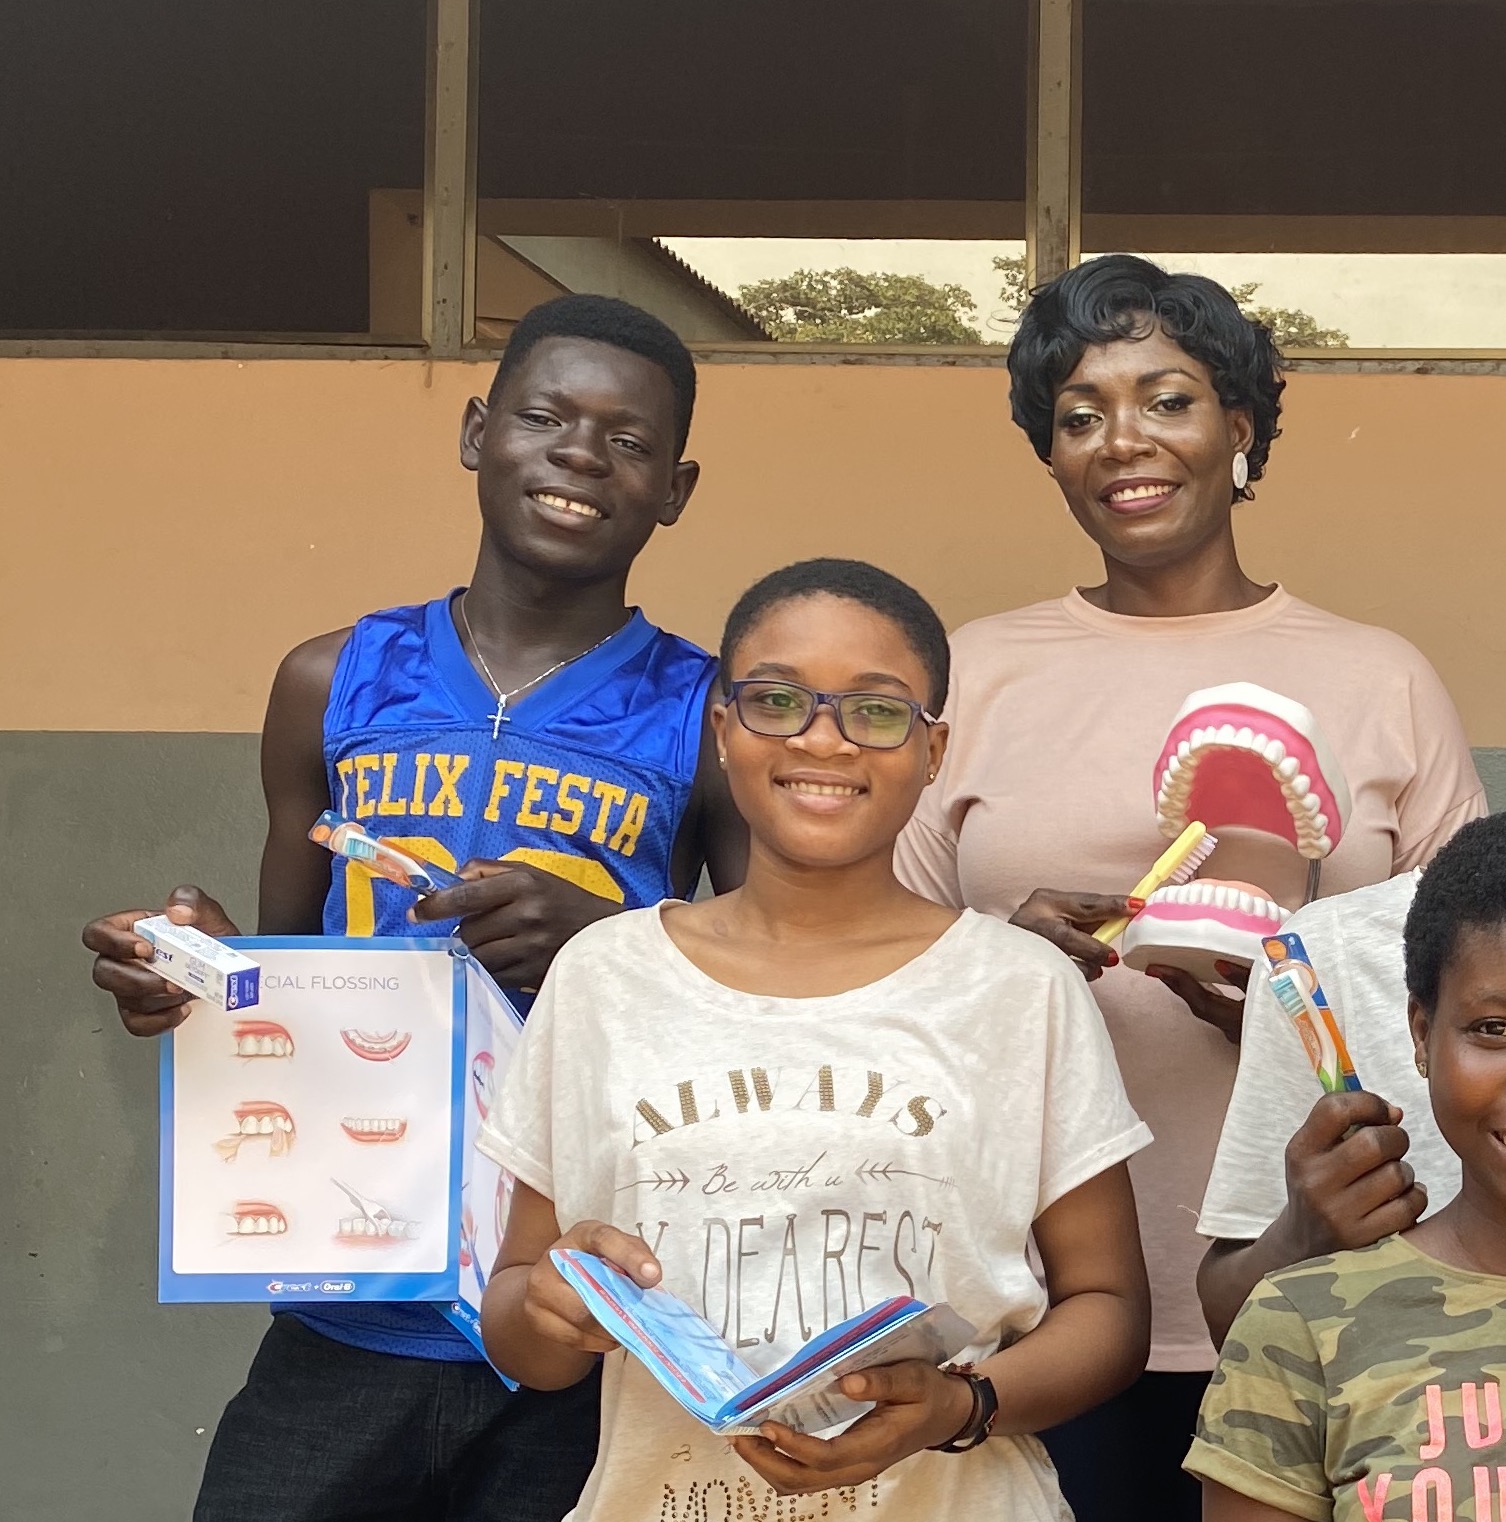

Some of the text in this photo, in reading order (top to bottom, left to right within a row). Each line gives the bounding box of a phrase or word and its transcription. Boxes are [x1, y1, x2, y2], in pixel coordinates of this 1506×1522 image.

[484, 759, 650, 858] FESTA
[152, 946, 174, 963] rest
[259, 975, 400, 990] CIAL FLOSSING
[630, 1064, 948, 1151] ALWAYS
[702, 1150, 845, 1195] Be with u
[702, 1209, 943, 1348] DEAREST
